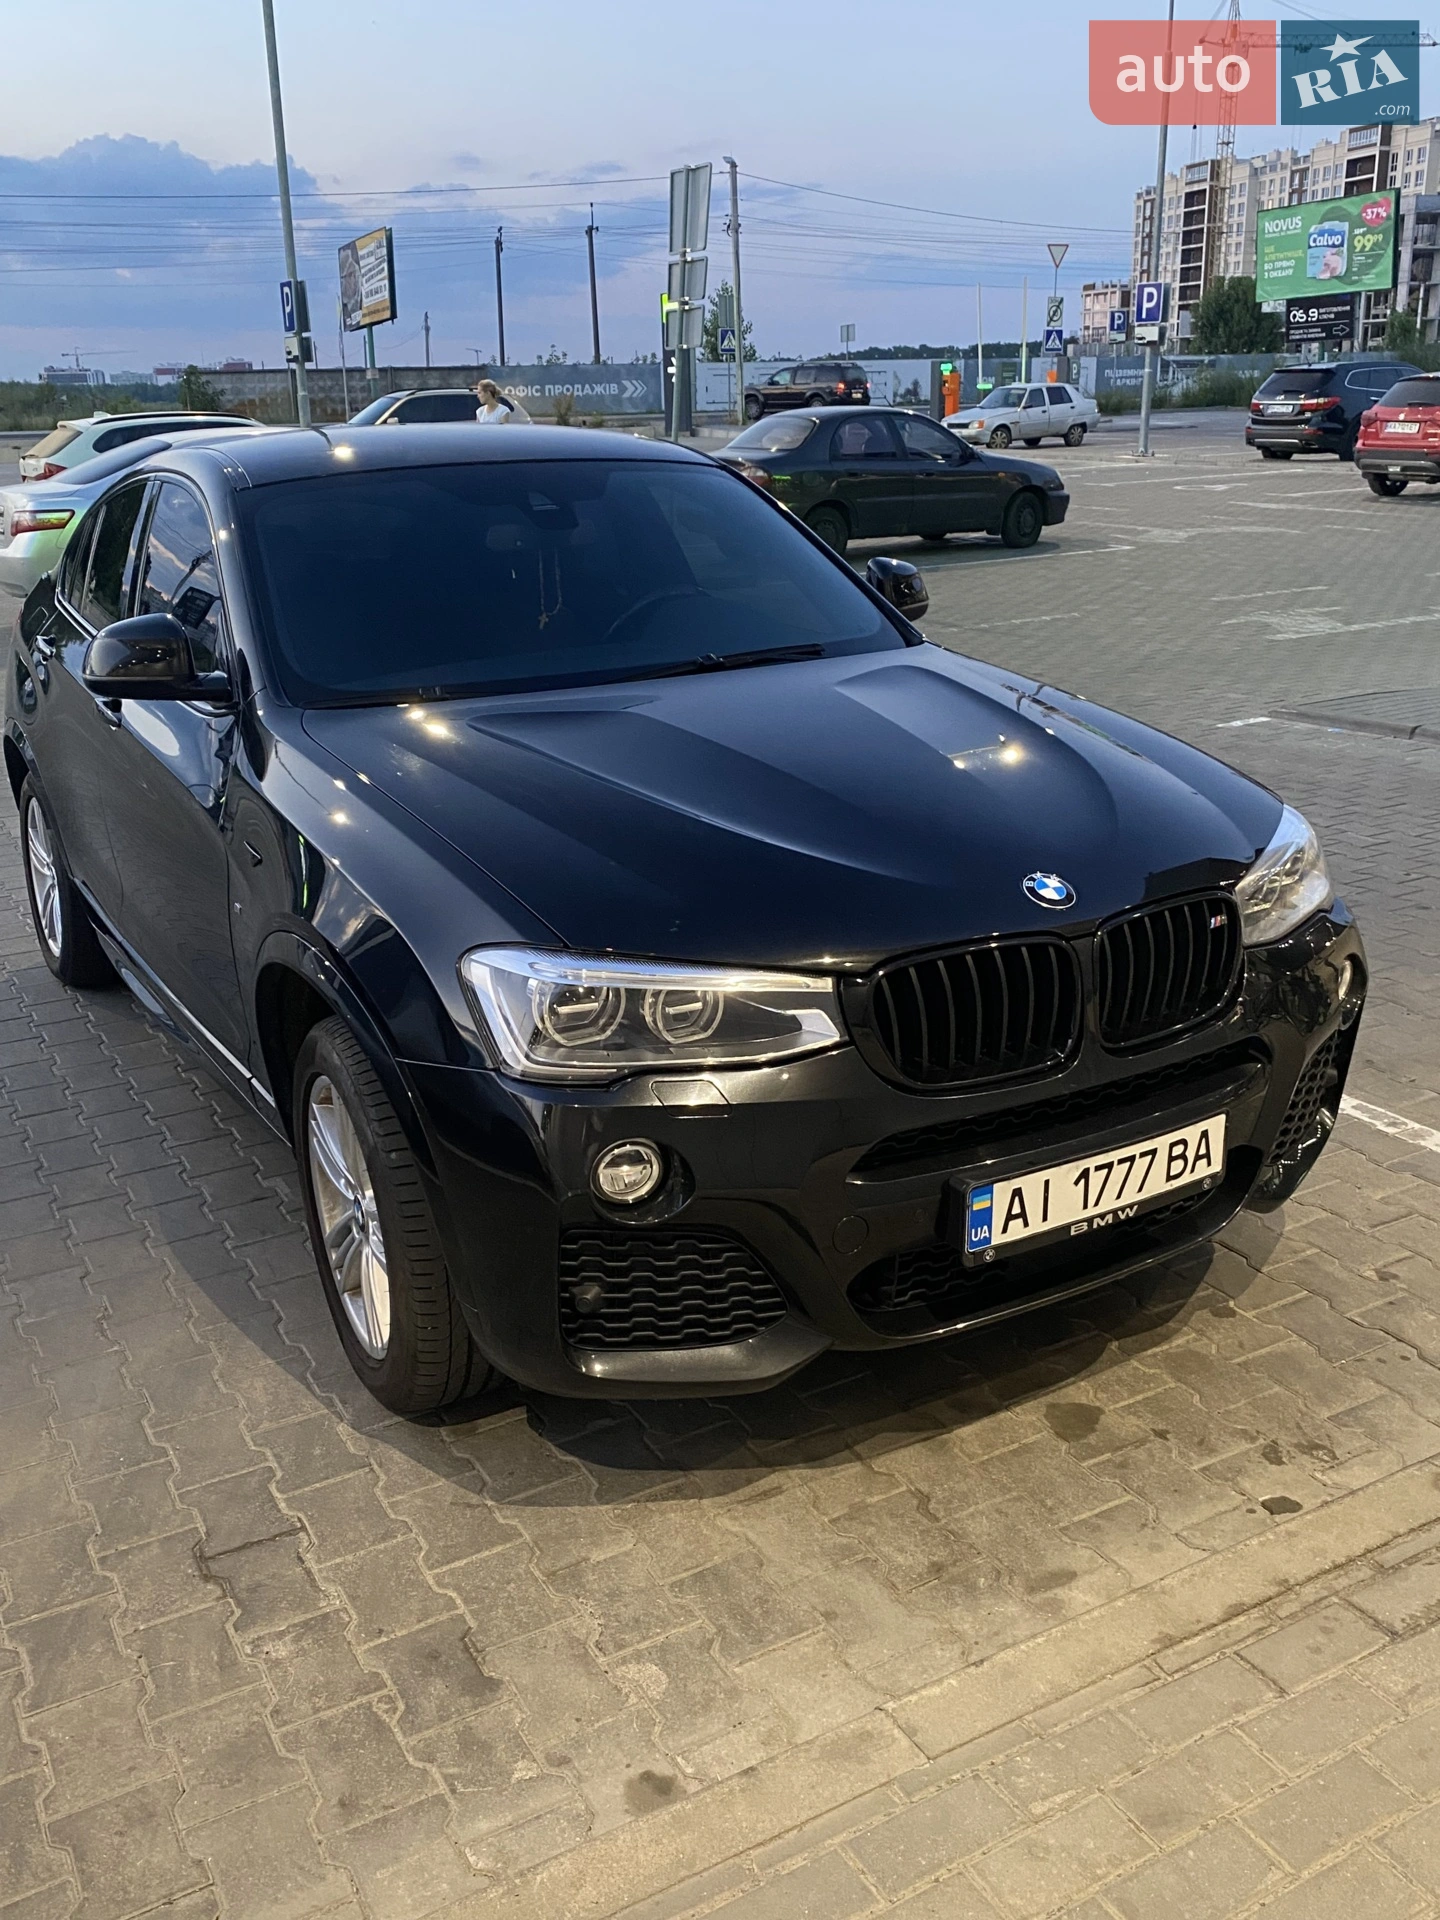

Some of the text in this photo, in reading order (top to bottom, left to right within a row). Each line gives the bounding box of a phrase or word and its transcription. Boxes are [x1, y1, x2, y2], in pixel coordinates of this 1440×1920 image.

[1362, 207, 1387, 219] -37%
[1264, 216, 1302, 234] NOVUS
[1309, 234, 1342, 247] Calvo
[1274, 259, 1296, 270] ПРЯМО
[282, 286, 292, 328] P
[1142, 286, 1158, 319] P
[1114, 312, 1124, 330] P
[1072, 363, 1078, 379] P
[1104, 368, 1146, 378] ПІДЗЕМНИ
[504, 383, 619, 398] ОФІС ПРОДАЖІВ
[1001, 1128, 1212, 1235] AI 1777 BA
[1070, 1204, 1139, 1236] BMW
[971, 1227, 990, 1242] UA
